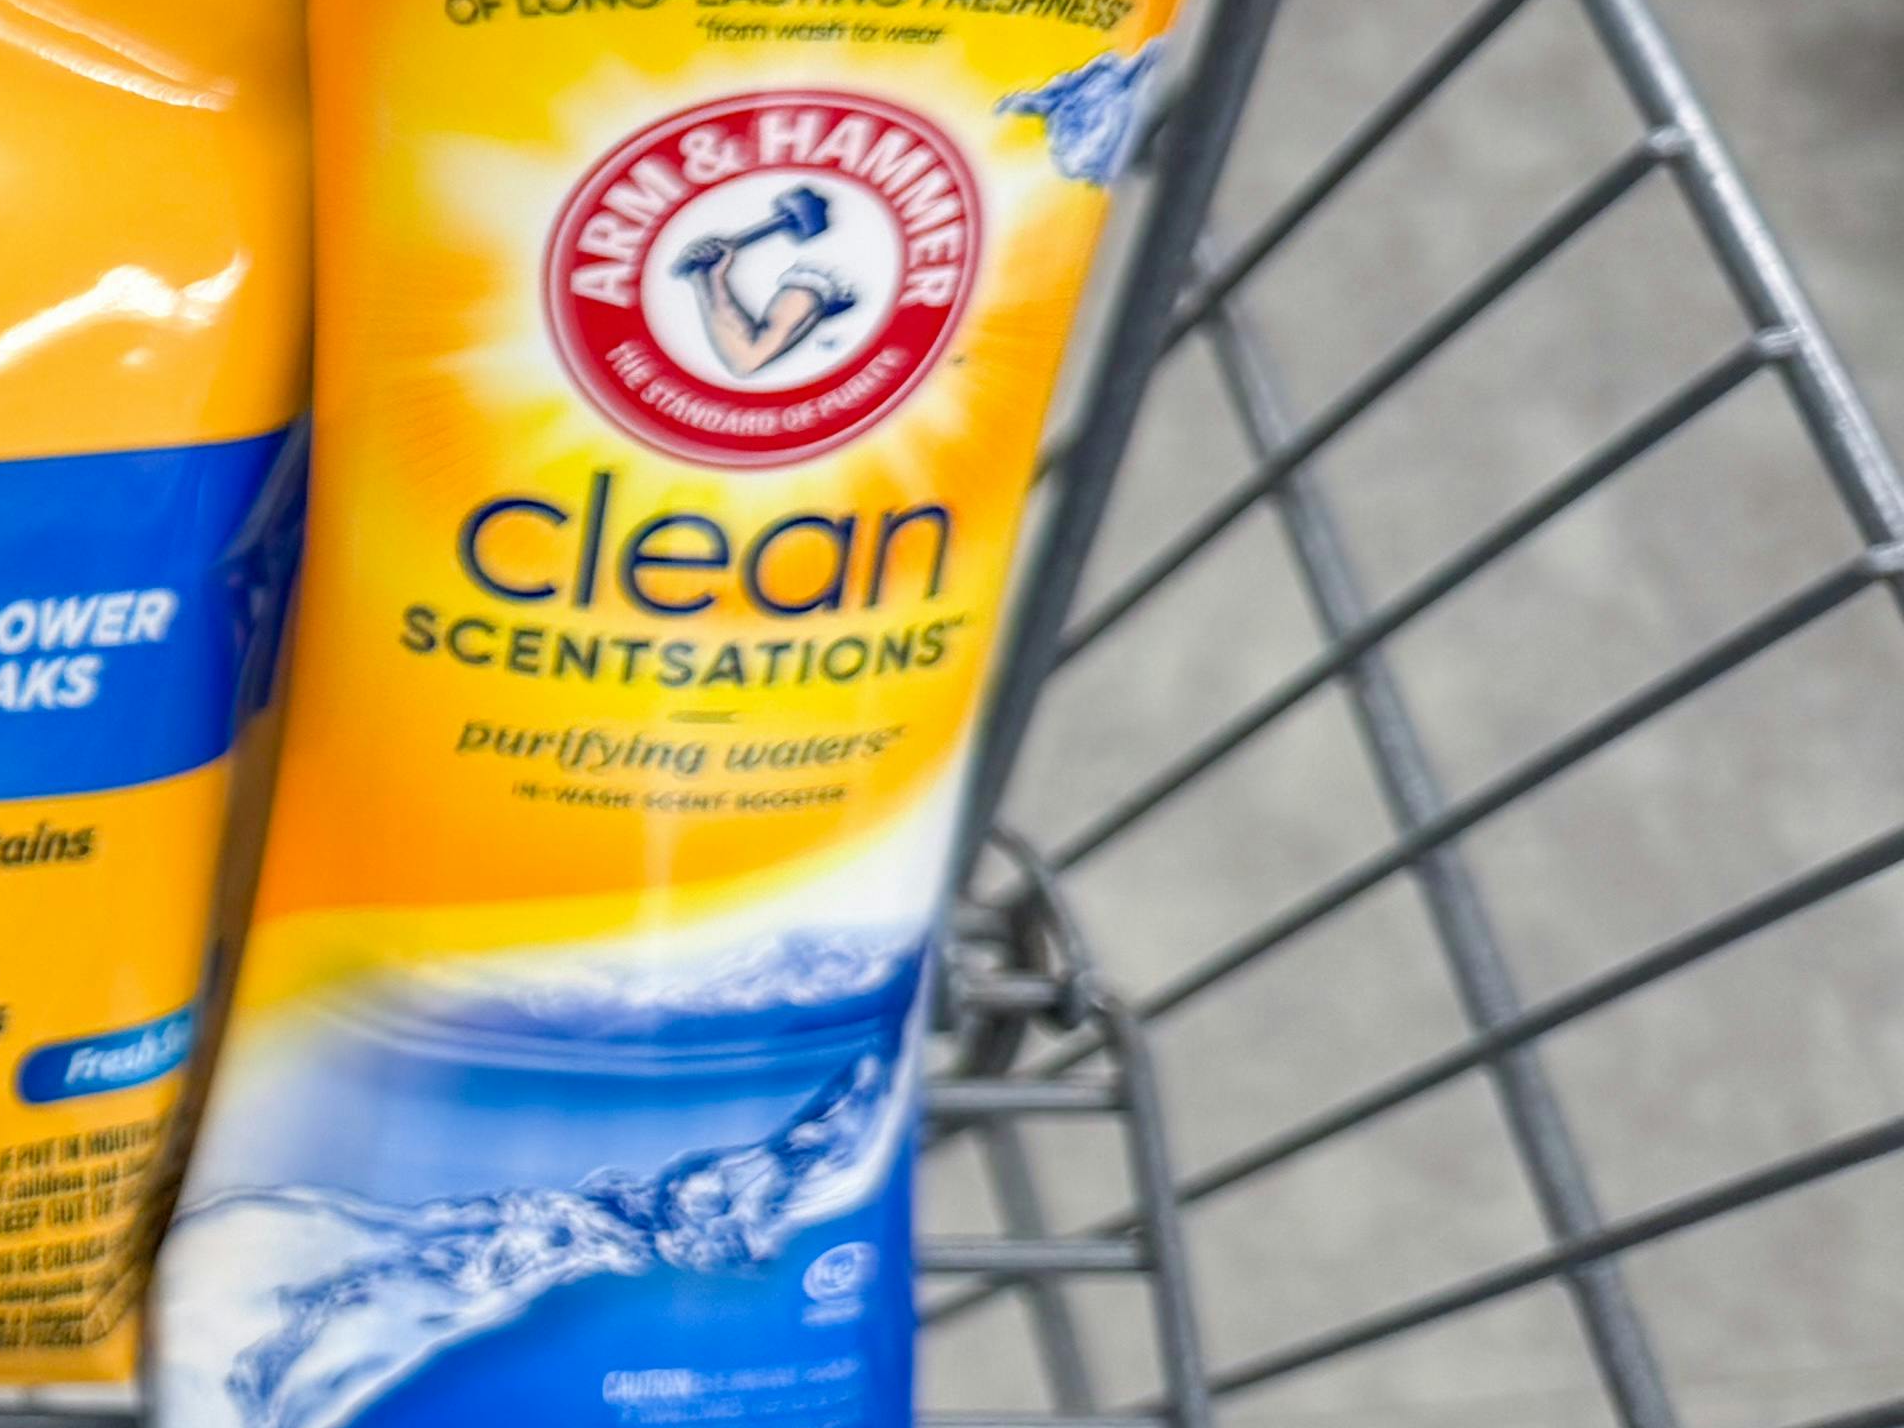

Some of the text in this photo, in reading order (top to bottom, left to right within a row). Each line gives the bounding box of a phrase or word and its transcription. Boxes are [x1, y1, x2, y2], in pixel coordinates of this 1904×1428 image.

[774, 18, 850, 46] wash
[852, 20, 883, 45] to
[570, 109, 969, 309] ARM & HAMMER
[640, 380, 780, 437] STANDARD
[457, 470, 954, 618] clean
[455, 720, 710, 778] purifying
